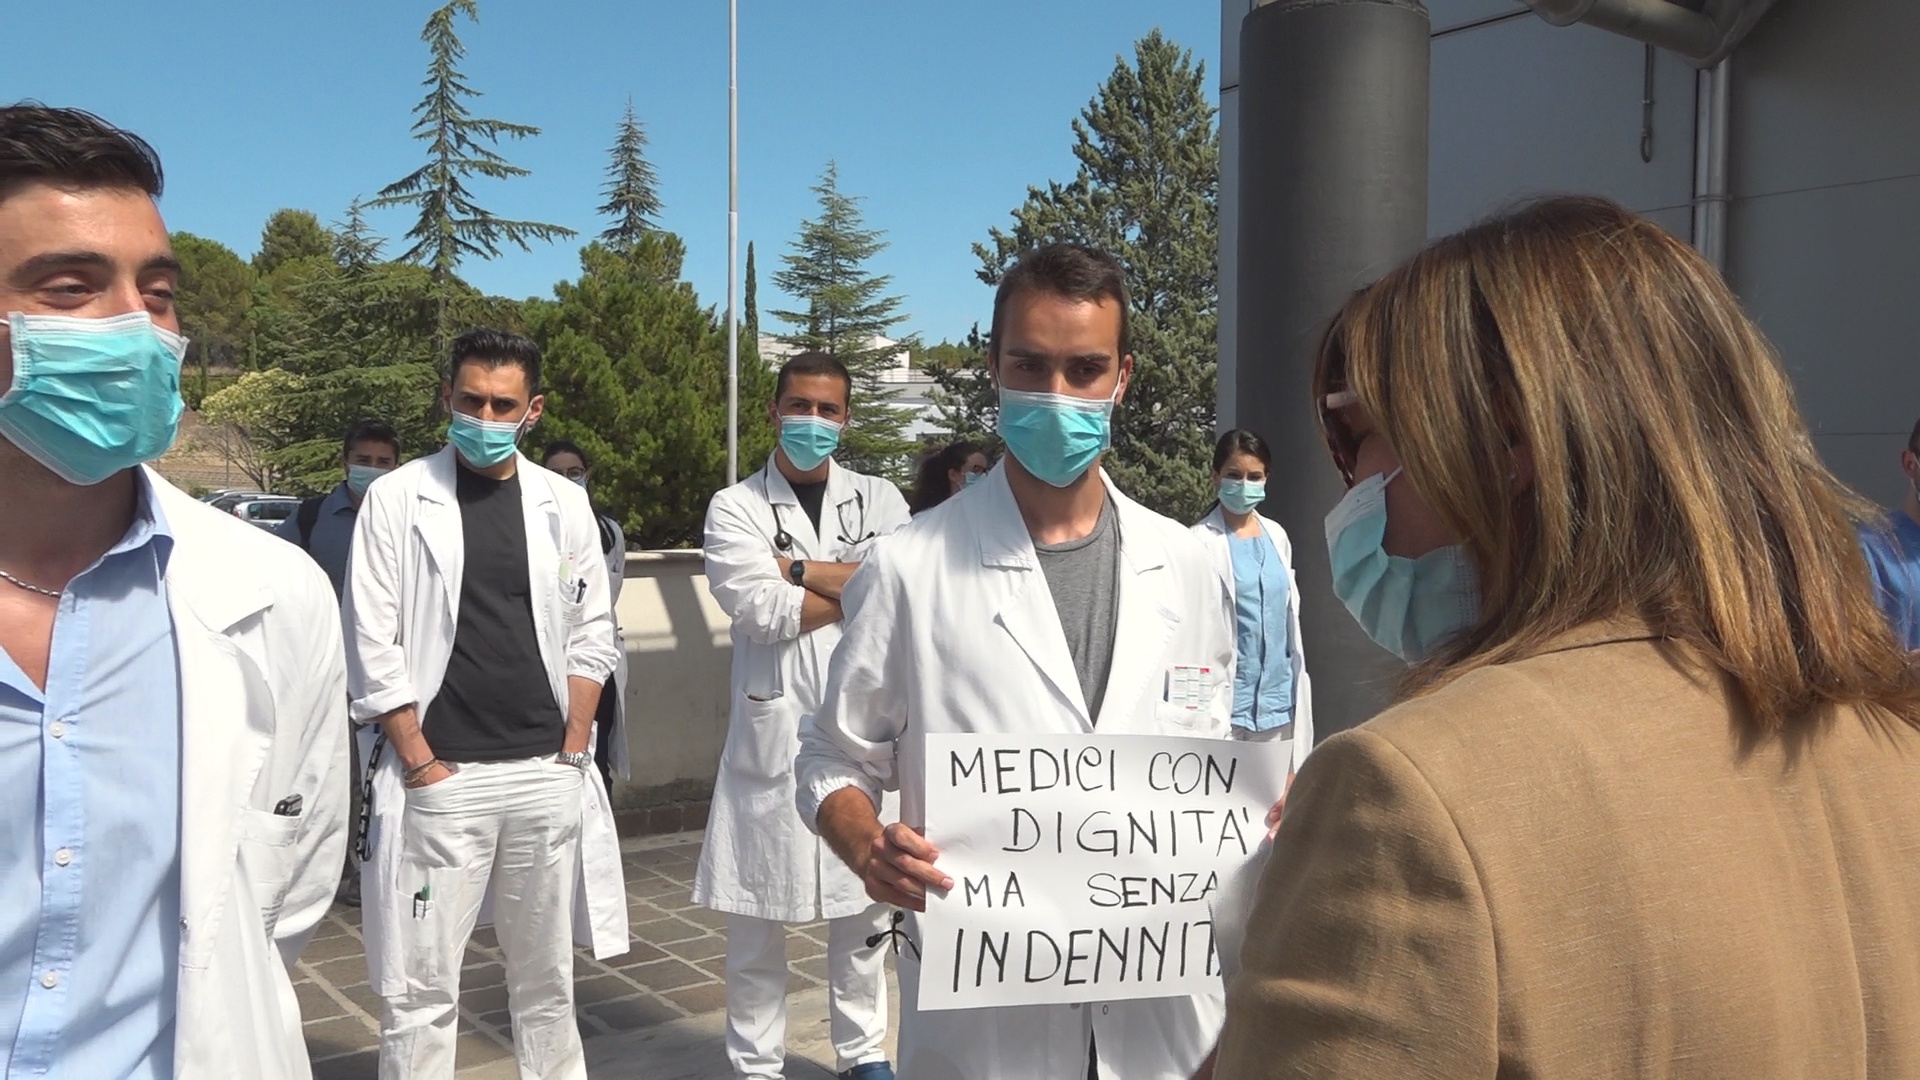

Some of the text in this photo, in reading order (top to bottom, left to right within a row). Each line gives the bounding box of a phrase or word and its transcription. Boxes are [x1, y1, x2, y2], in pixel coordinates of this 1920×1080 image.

[950, 747, 1237, 796] MEDICI CON
[963, 871, 1218, 908] MA SENZA
[953, 921, 1221, 993] INDENNIT
